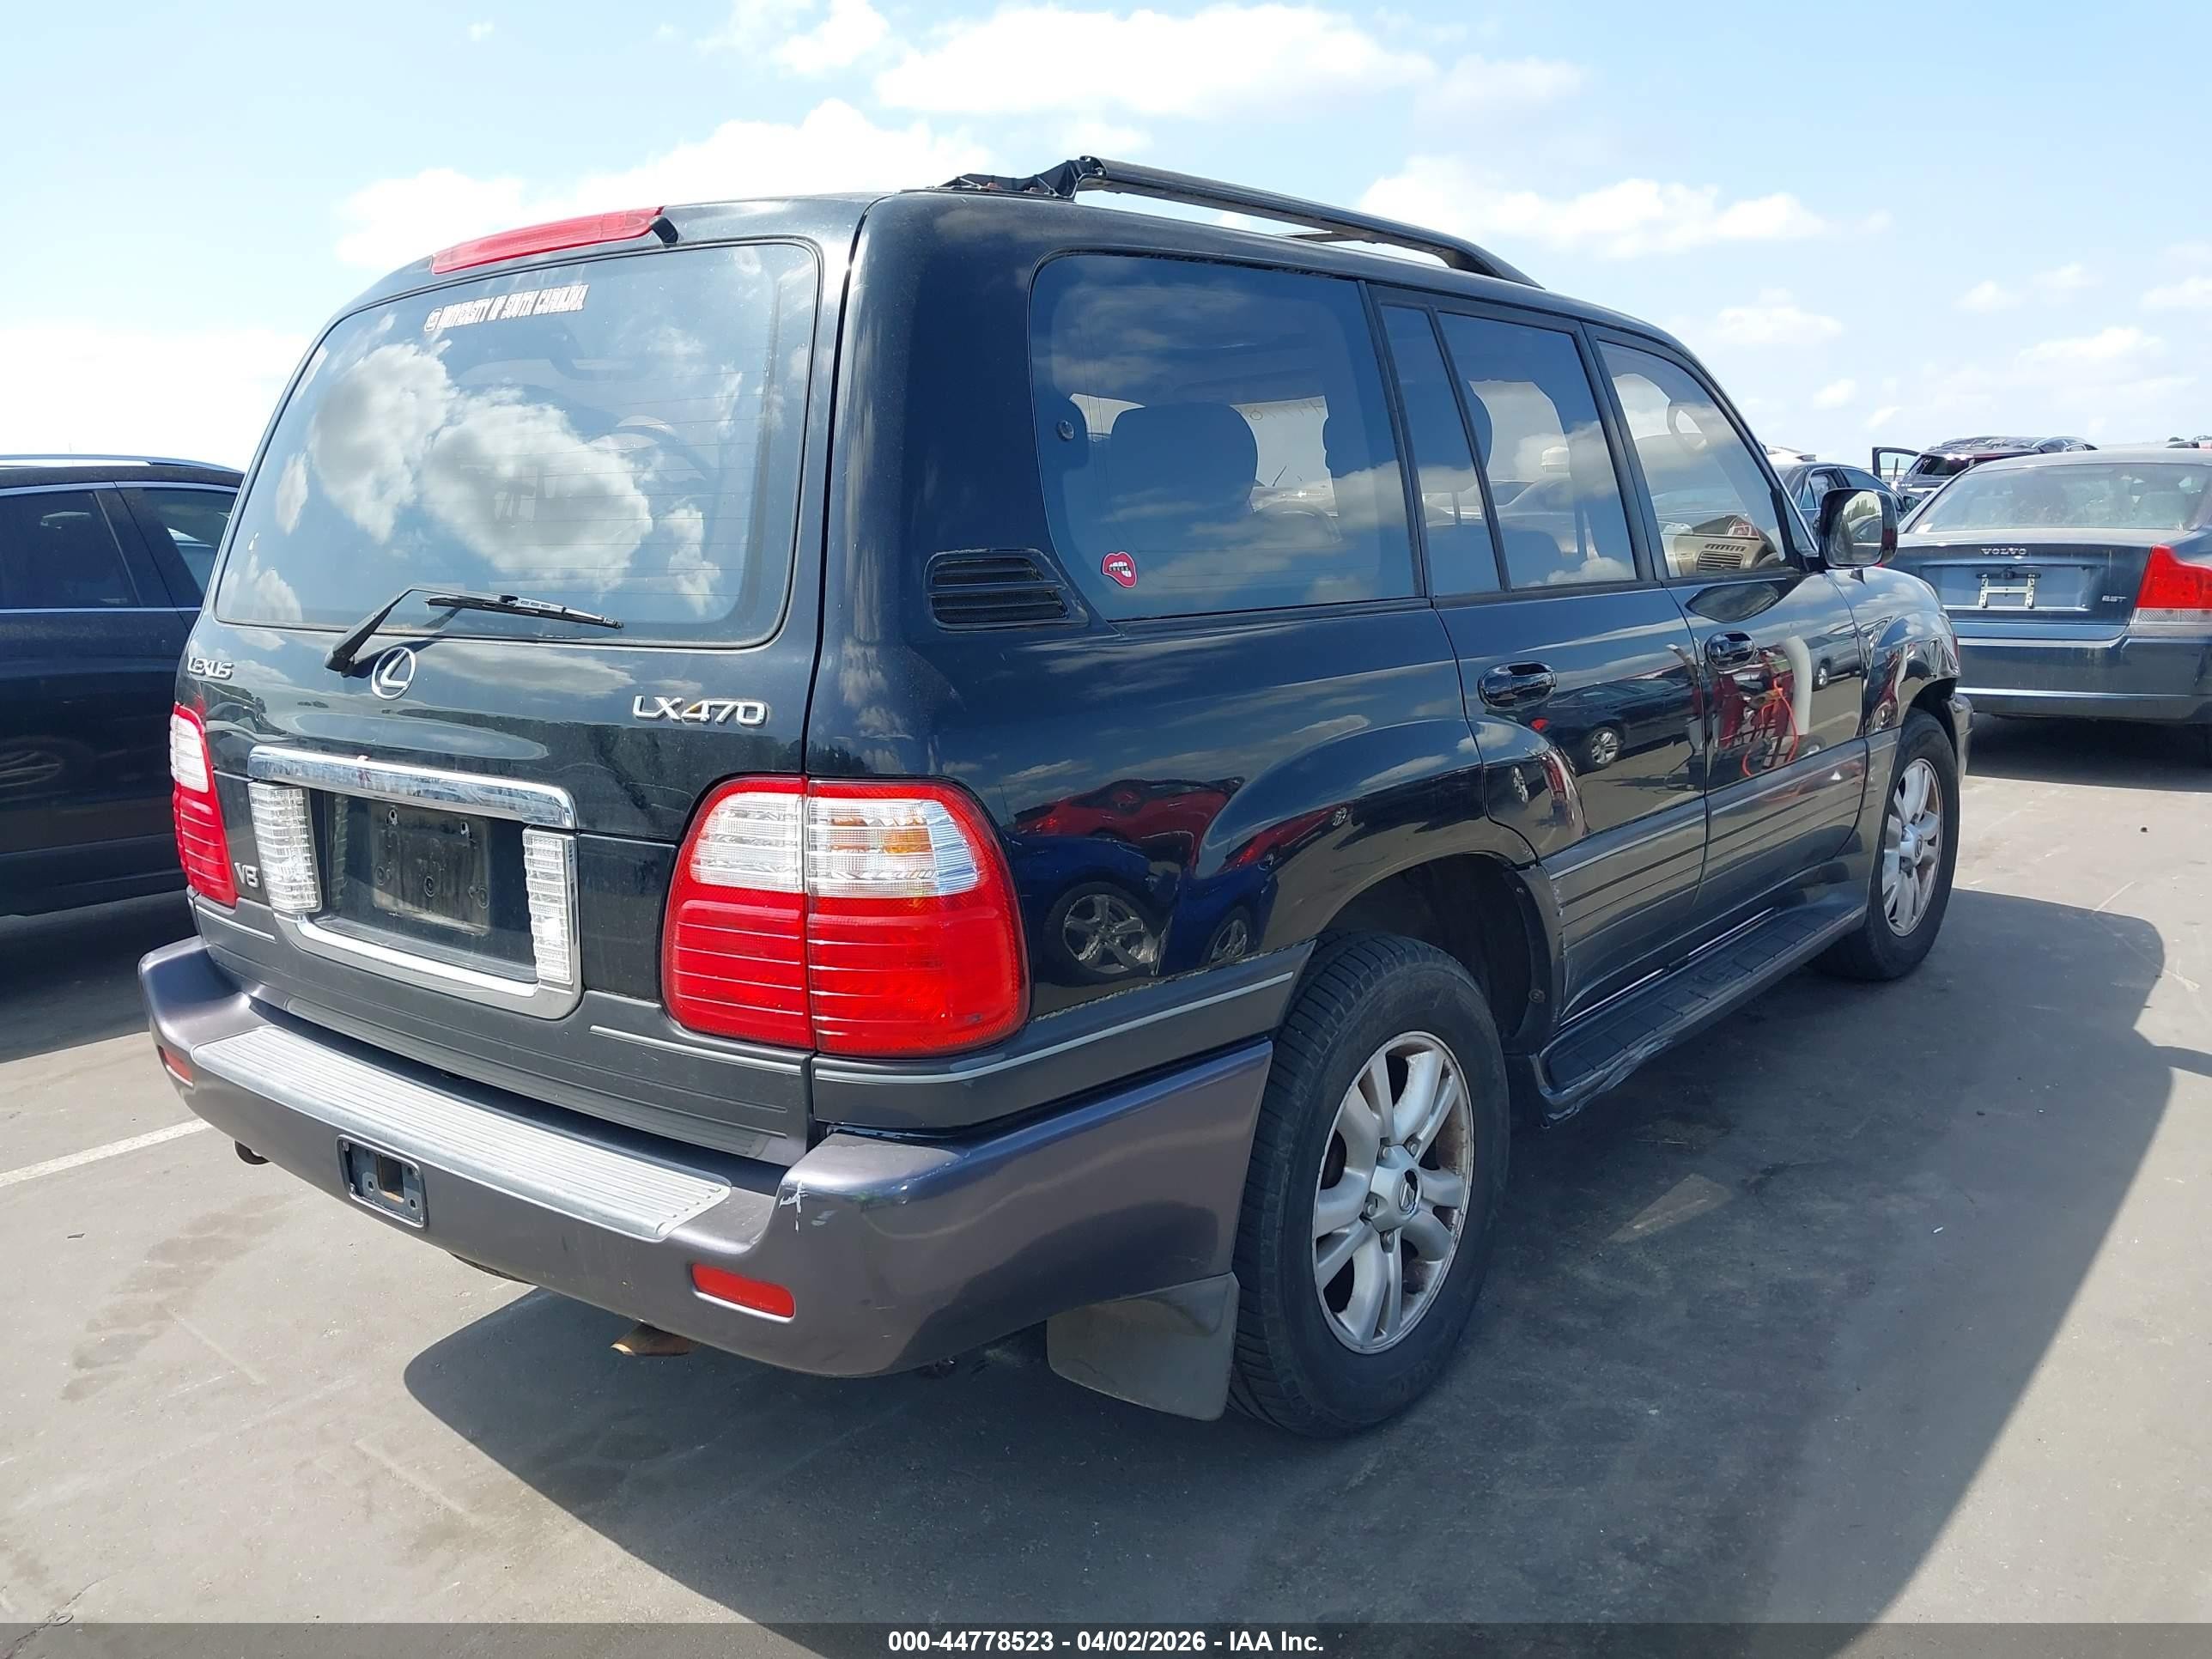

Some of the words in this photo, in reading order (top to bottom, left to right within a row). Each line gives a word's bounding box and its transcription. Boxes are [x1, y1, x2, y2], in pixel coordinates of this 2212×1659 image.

[487, 295, 507, 321] OF
[500, 289, 540, 319] SOUTH
[532, 283, 590, 315] CAROLINA
[1980, 547, 2027, 556] VOLVO
[187, 657, 234, 680] LEXUS
[234, 861, 260, 889] V8
